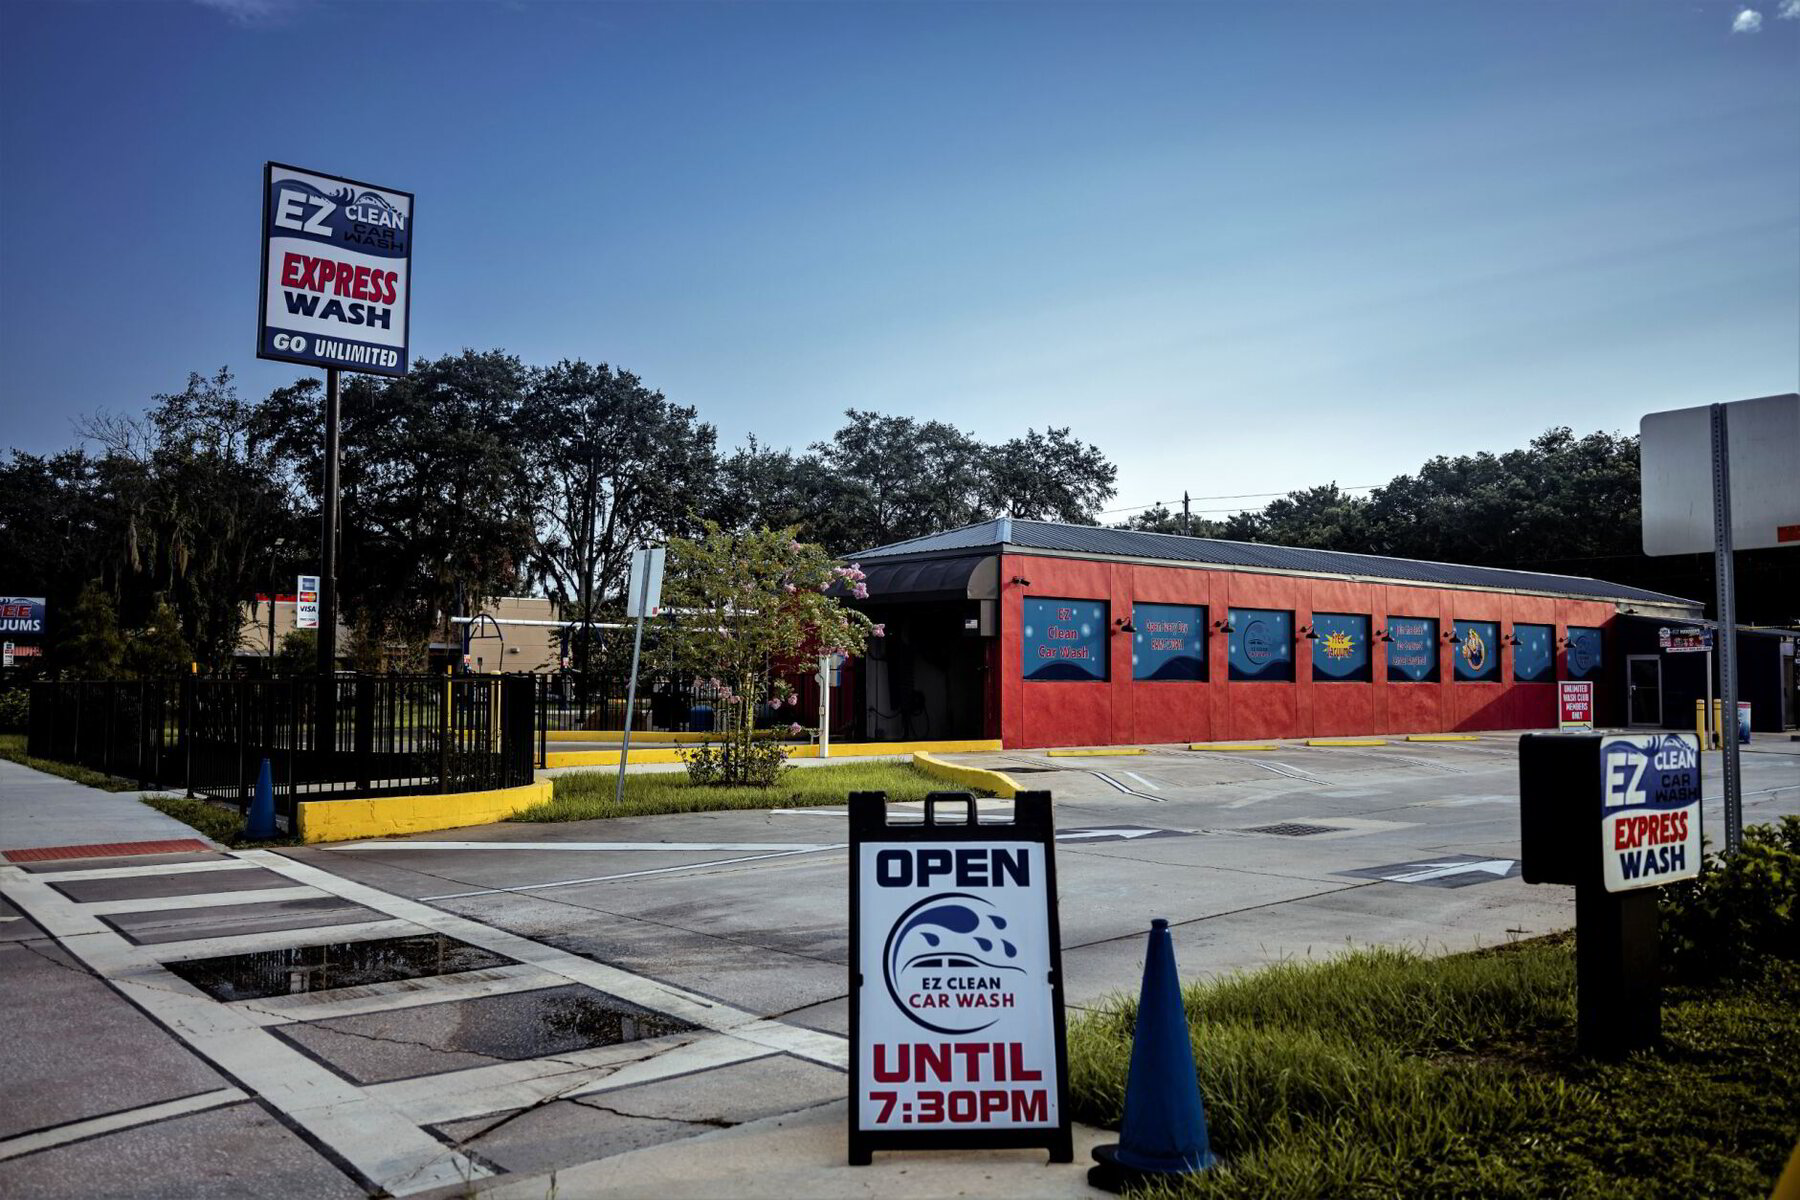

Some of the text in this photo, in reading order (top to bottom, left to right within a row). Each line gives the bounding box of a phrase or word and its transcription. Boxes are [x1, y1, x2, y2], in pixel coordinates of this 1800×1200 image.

[275, 188, 337, 237] EZ
[345, 205, 404, 230] CLEAN
[344, 231, 403, 252] WASH
[354, 223, 394, 239] CAR
[281, 252, 398, 305] EXPRESS
[283, 291, 392, 330] WASH
[273, 333, 398, 368] GO UNLIMITED
[0, 603, 32, 618] EE
[0, 619, 41, 631] UUMS
[1048, 626, 1079, 640] Clean
[1038, 645, 1089, 659] Car Wash
[1654, 751, 1696, 770] CLEAN
[1605, 752, 1649, 807] EZ
[1661, 774, 1690, 787] CAR
[1655, 787, 1697, 803] WASH
[1614, 810, 1688, 850] EXPRESS
[876, 849, 1030, 888] OPEN
[1619, 844, 1685, 880] WASH
[922, 977, 1001, 990] EZ CLEAN
[909, 993, 1014, 1008] CAR WASH
[873, 1042, 1042, 1083] UNTIL
[869, 1089, 1048, 1124] 7:30PM
